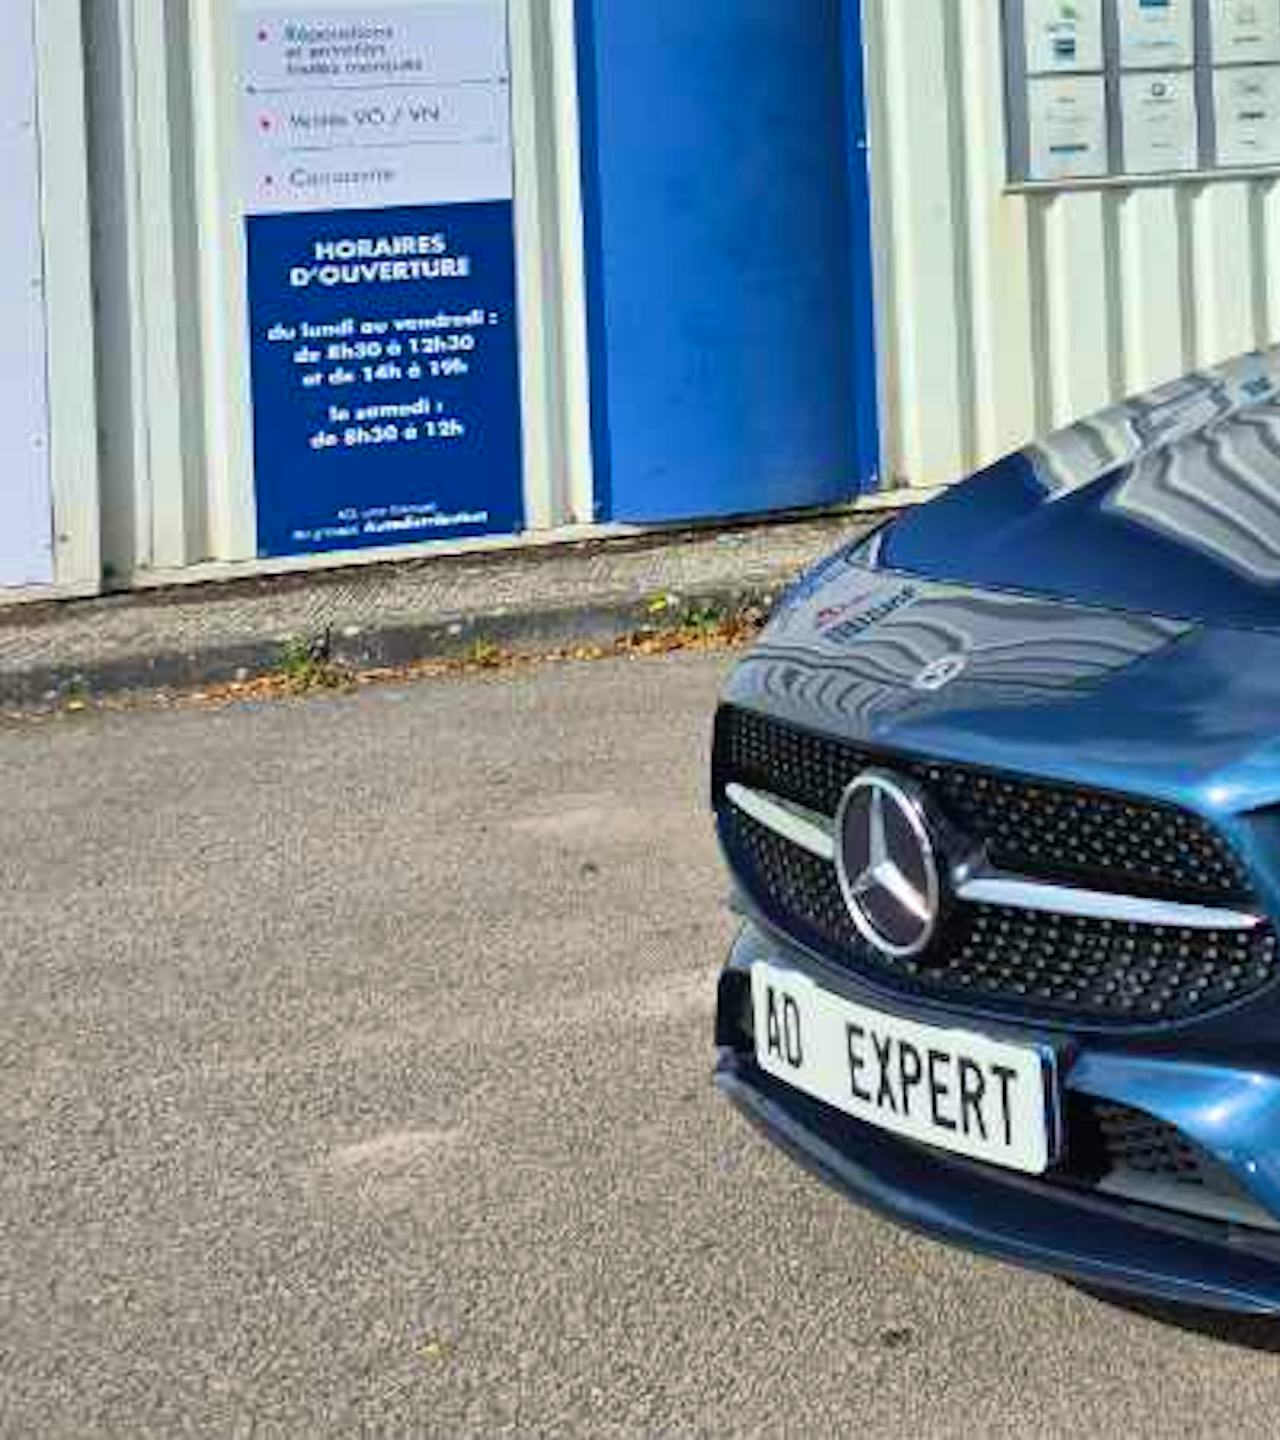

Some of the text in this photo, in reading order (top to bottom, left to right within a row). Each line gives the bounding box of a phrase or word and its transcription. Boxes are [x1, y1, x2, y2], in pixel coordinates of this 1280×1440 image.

[314, 233, 446, 262] HORAIRES
[289, 257, 470, 287] D'OUVERTURE
[267, 324, 296, 342] du
[302, 319, 354, 339] lundi
[360, 320, 388, 336] au
[393, 309, 484, 332] vendredi
[293, 346, 322, 364] de
[327, 341, 382, 361] 8h30
[408, 334, 475, 355] 12h30
[302, 372, 324, 388] et
[329, 366, 356, 386] de
[364, 362, 402, 383] 14h
[429, 359, 468, 377] 19h
[328, 404, 350, 422] le
[356, 398, 431, 419] samedi
[310, 428, 338, 449] de
[343, 423, 398, 446] 8h30
[424, 418, 465, 438] 12h
[766, 987, 1018, 1146] AD EXPERT
